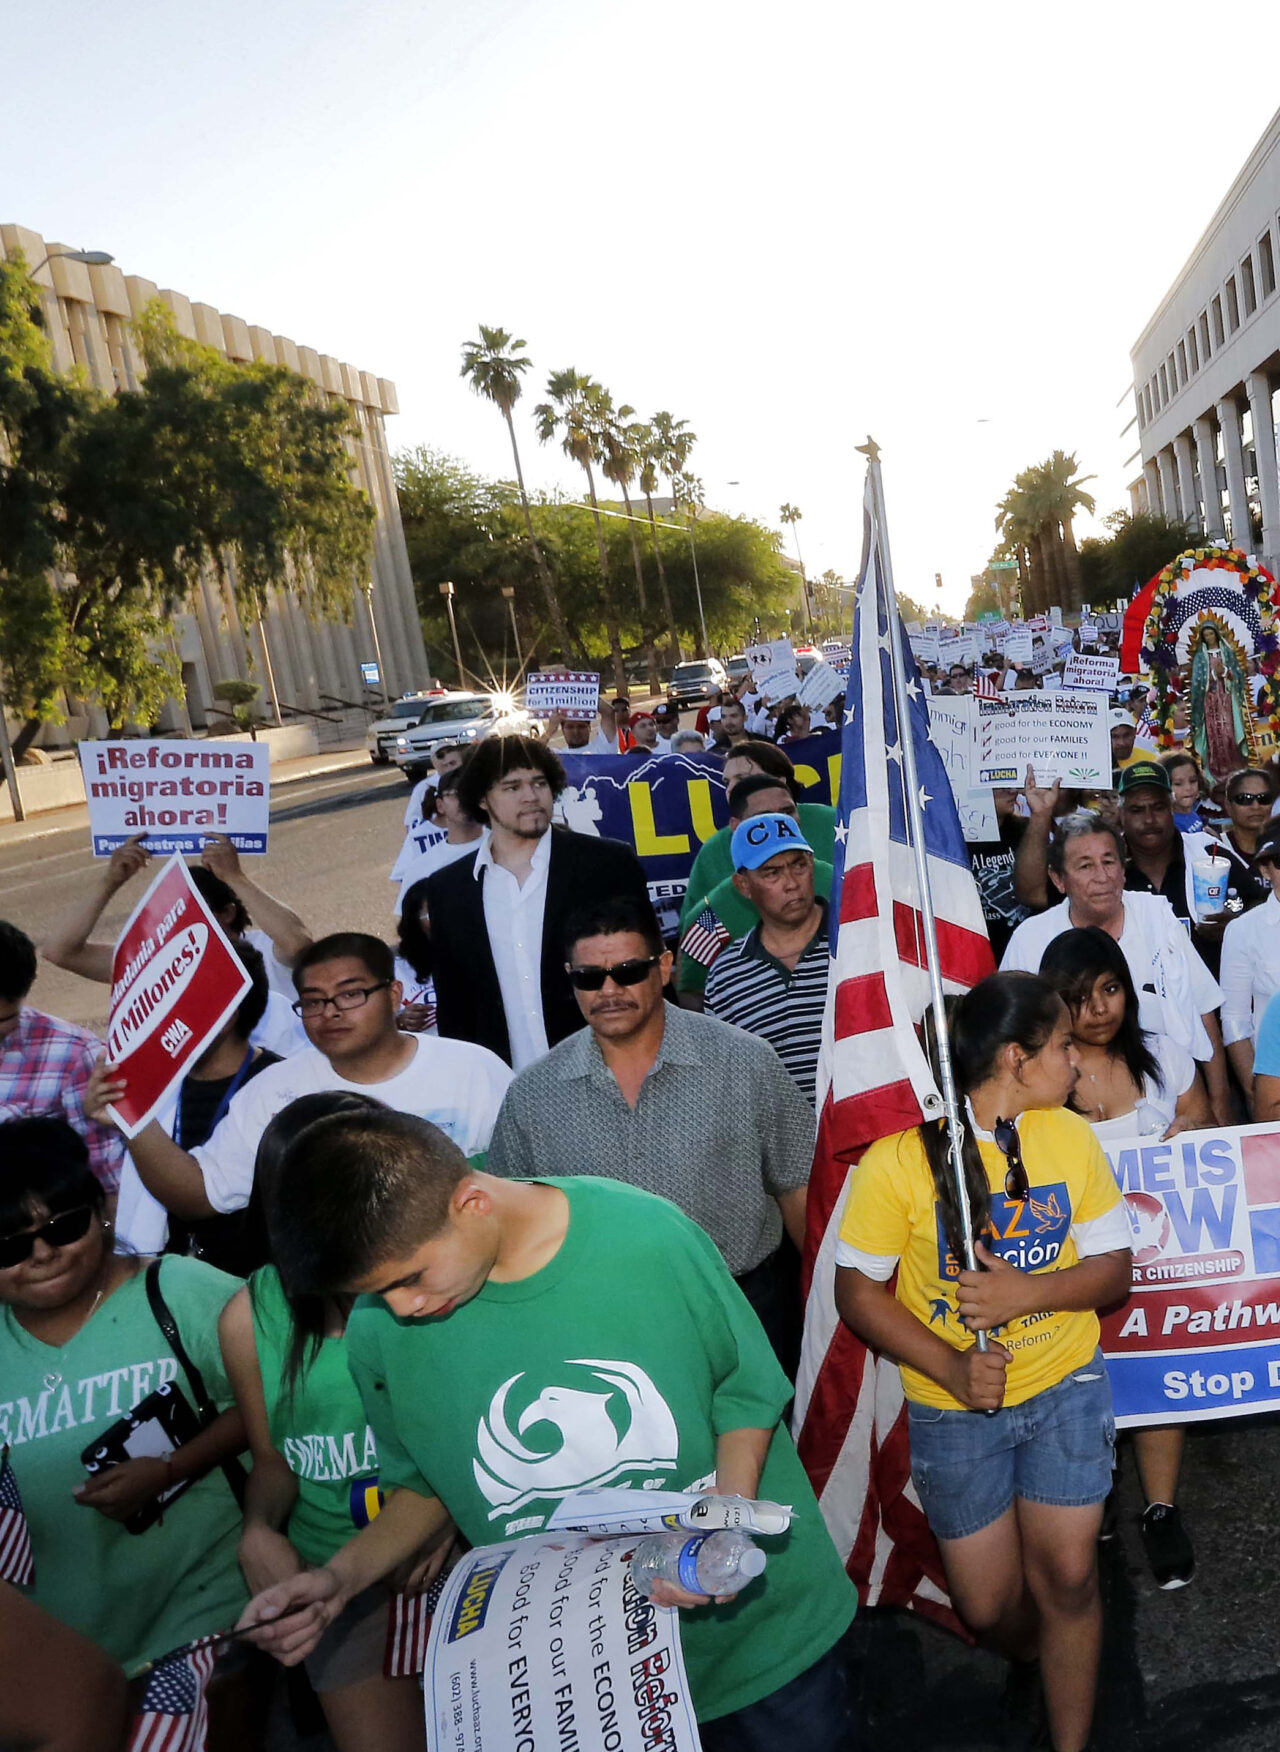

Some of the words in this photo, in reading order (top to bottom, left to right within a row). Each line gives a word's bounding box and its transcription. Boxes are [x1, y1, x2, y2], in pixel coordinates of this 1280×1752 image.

[1066, 667, 1116, 677] migratoria
[1070, 657, 1114, 667] ¡Reforma
[530, 687, 596, 695] CITIZENSHIP
[1073, 678, 1104, 686] ahora!
[556, 696, 596, 706] million
[1056, 695, 1097, 714] Reform
[995, 720, 1015, 730] good
[1050, 720, 1093, 728] ECONOMY
[995, 735, 1016, 745] good
[1051, 735, 1088, 744] FAMILIES
[98, 747, 254, 774] ¡Reforma
[996, 751, 1016, 760] good
[1034, 751, 1078, 759] EVERYONE
[90, 775, 264, 801] migratoria
[991, 770, 1016, 778] LUCHA
[125, 804, 227, 827] ahora!
[972, 854, 979, 870] A
[980, 847, 1015, 872] Legend
[156, 898, 186, 945] para
[108, 1029, 122, 1061] 11
[121, 930, 200, 1042] Millones!
[160, 1019, 189, 1053] CWA
[1106, 1145, 1175, 1192] ME
[1182, 1139, 1236, 1188] IS
[1146, 1258, 1241, 1281] CITIZENSHIP
[1119, 1308, 1149, 1338] A
[1163, 1370, 1255, 1400] Stop
[512, 1561, 540, 1611] good
[588, 1578, 607, 1608] for
[456, 1570, 495, 1638] LUCHA
[550, 1596, 569, 1629] for
[508, 1616, 528, 1649] for
[589, 1615, 606, 1657] the
[550, 1638, 566, 1677] our
[509, 1657, 534, 1752] EVERYO
[593, 1661, 623, 1752] ECONO
[631, 1647, 679, 1752] Refor
